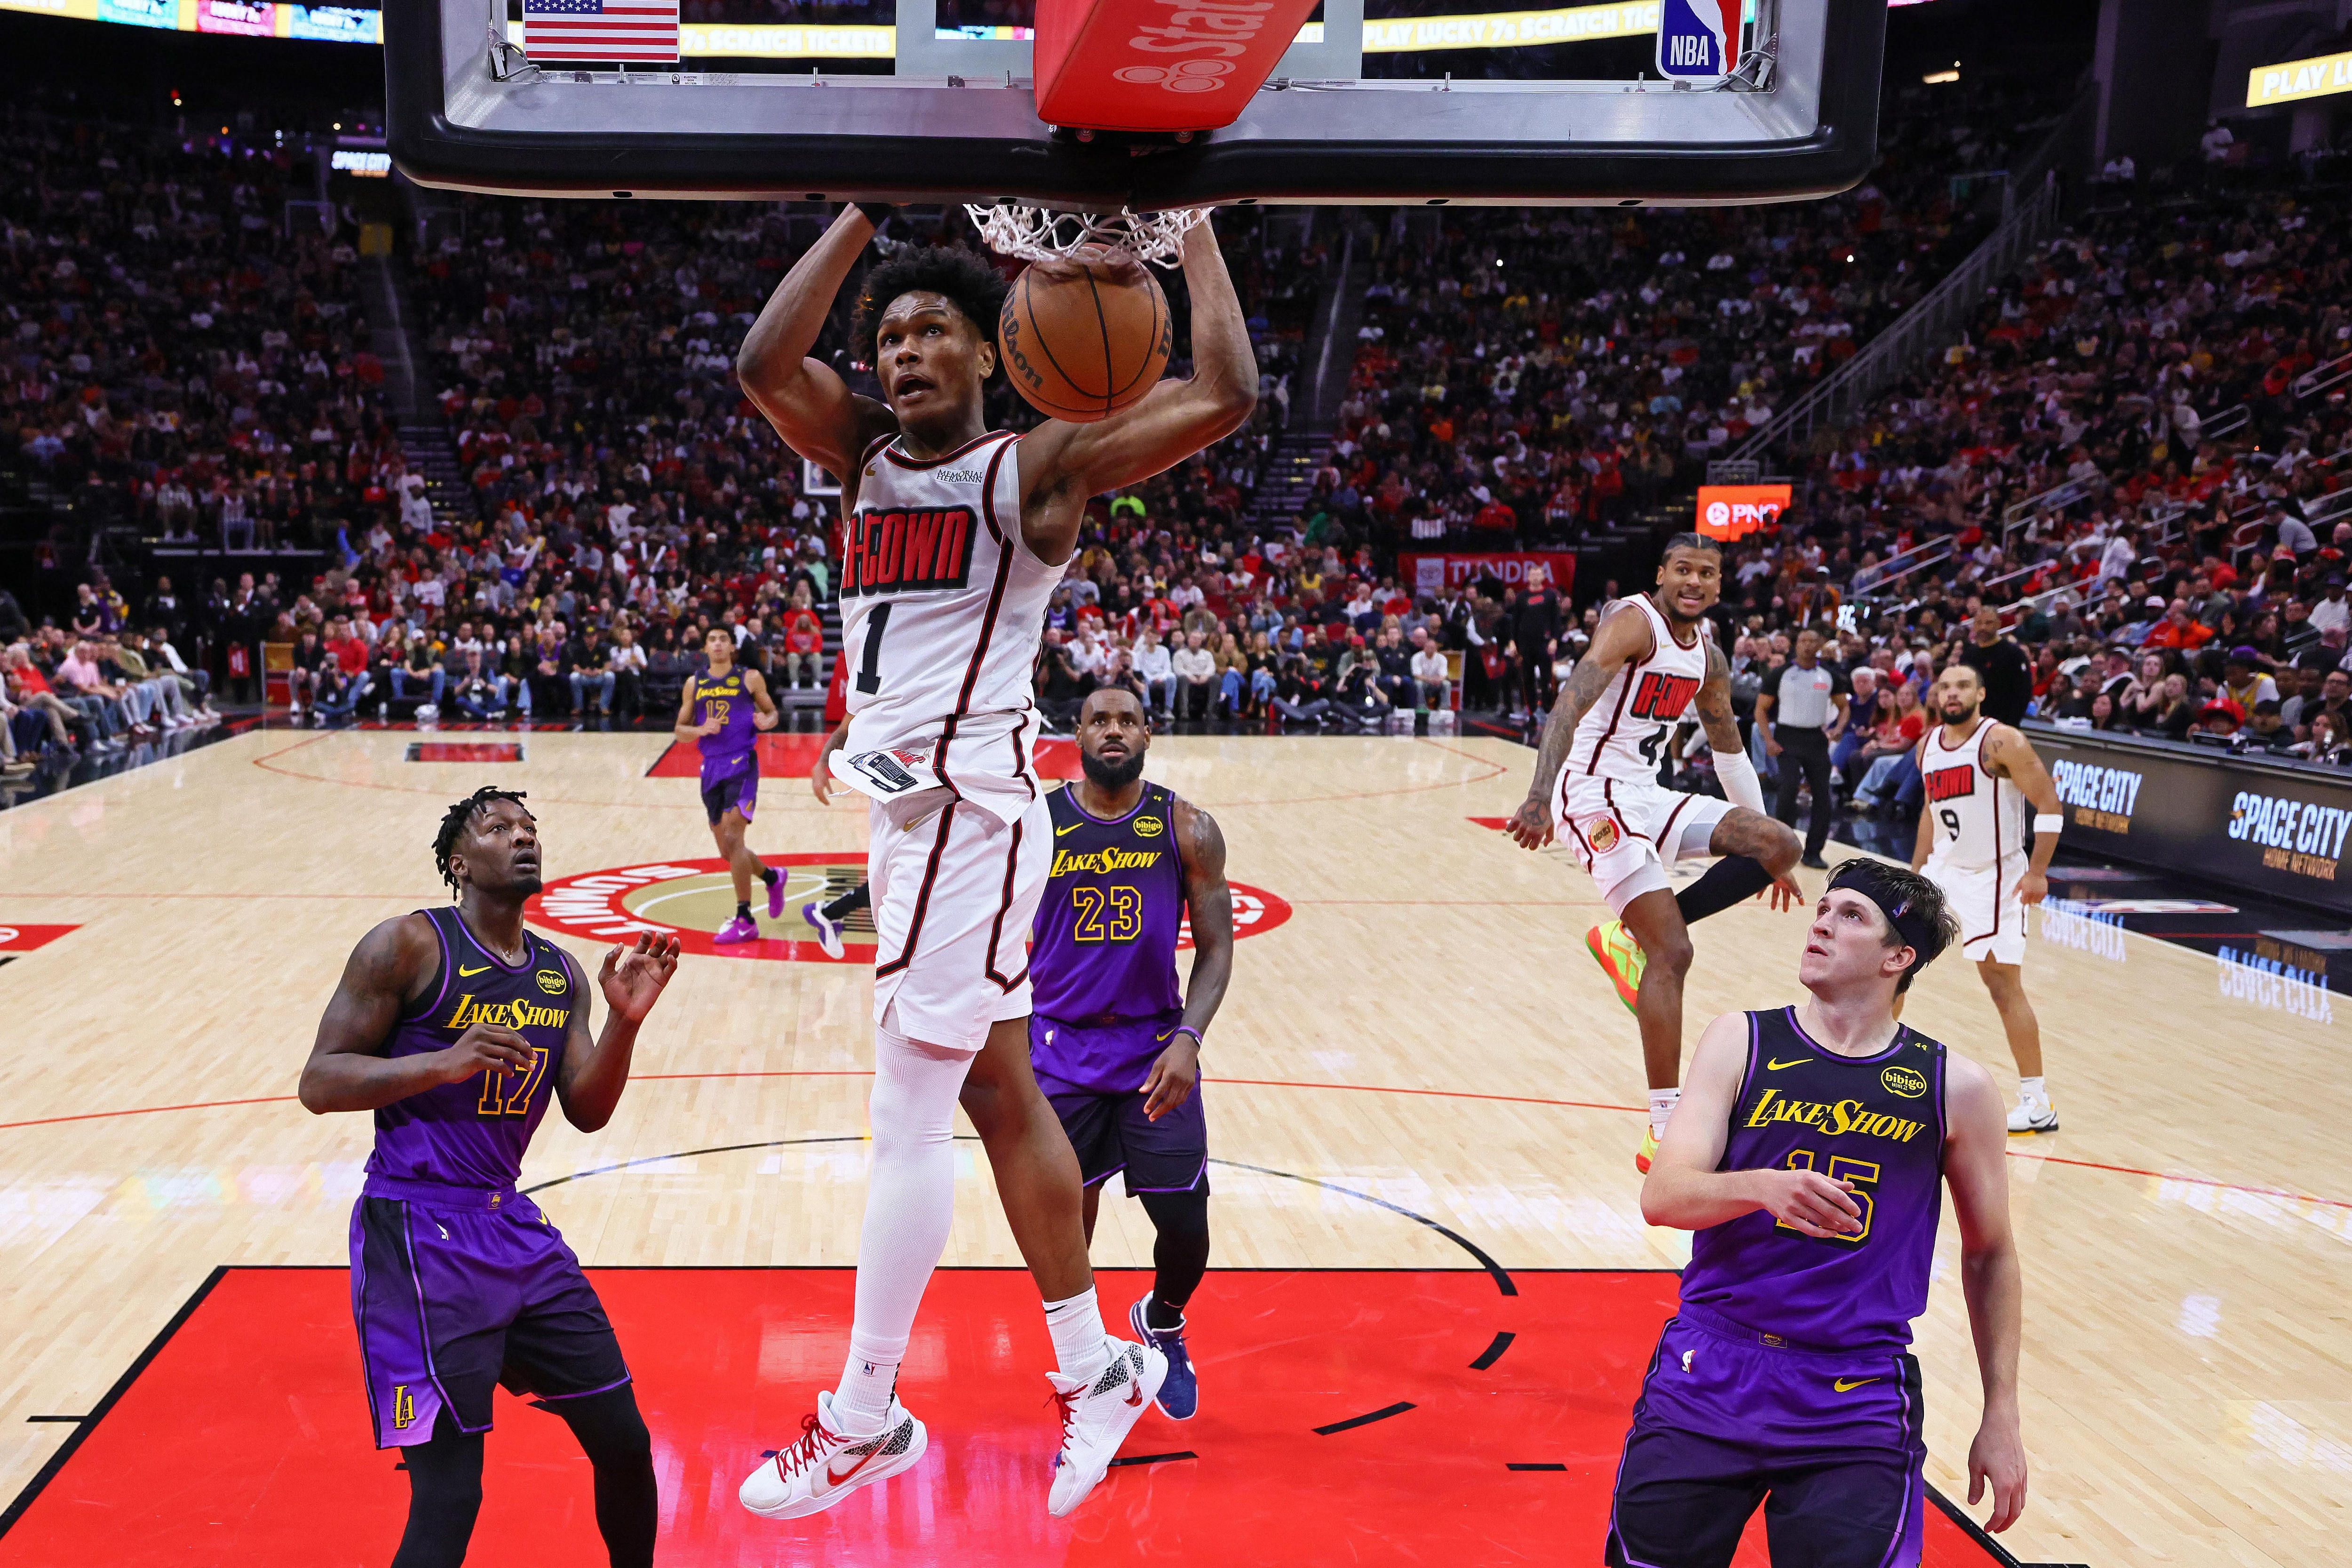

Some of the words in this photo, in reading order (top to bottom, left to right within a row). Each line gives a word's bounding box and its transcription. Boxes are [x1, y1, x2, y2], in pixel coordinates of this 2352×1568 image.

[708, 30, 802, 52] SCRATCH
[805, 32, 890, 52] TICKETS
[1363, 24, 1413, 47] PLAY
[1417, 21, 1486, 45] LUCKY
[1520, 10, 1618, 40] SCRATCH
[1670, 36, 1708, 66] NBA
[2262, 64, 2328, 98] PLAY
[937, 473, 982, 483] HERMANN
[938, 469, 983, 478] MEMORIAL
[855, 601, 892, 696] 1
[706, 700, 730, 725] 12
[1639, 724, 1668, 766] 4
[2052, 759, 2105, 809] SPACE
[2099, 768, 2143, 816] CITY
[1136, 821, 1161, 831] bibigo
[1940, 810, 1960, 841] 9
[2228, 791, 2301, 850] SPACE
[2296, 804, 2352, 860] CITY
[2290, 852, 2337, 881] NETWORK
[1073, 886, 1142, 941] 23
[539, 975, 564, 987] bibigo
[477, 1047, 549, 1115] 17
[1885, 1072, 1924, 1090] bibigo
